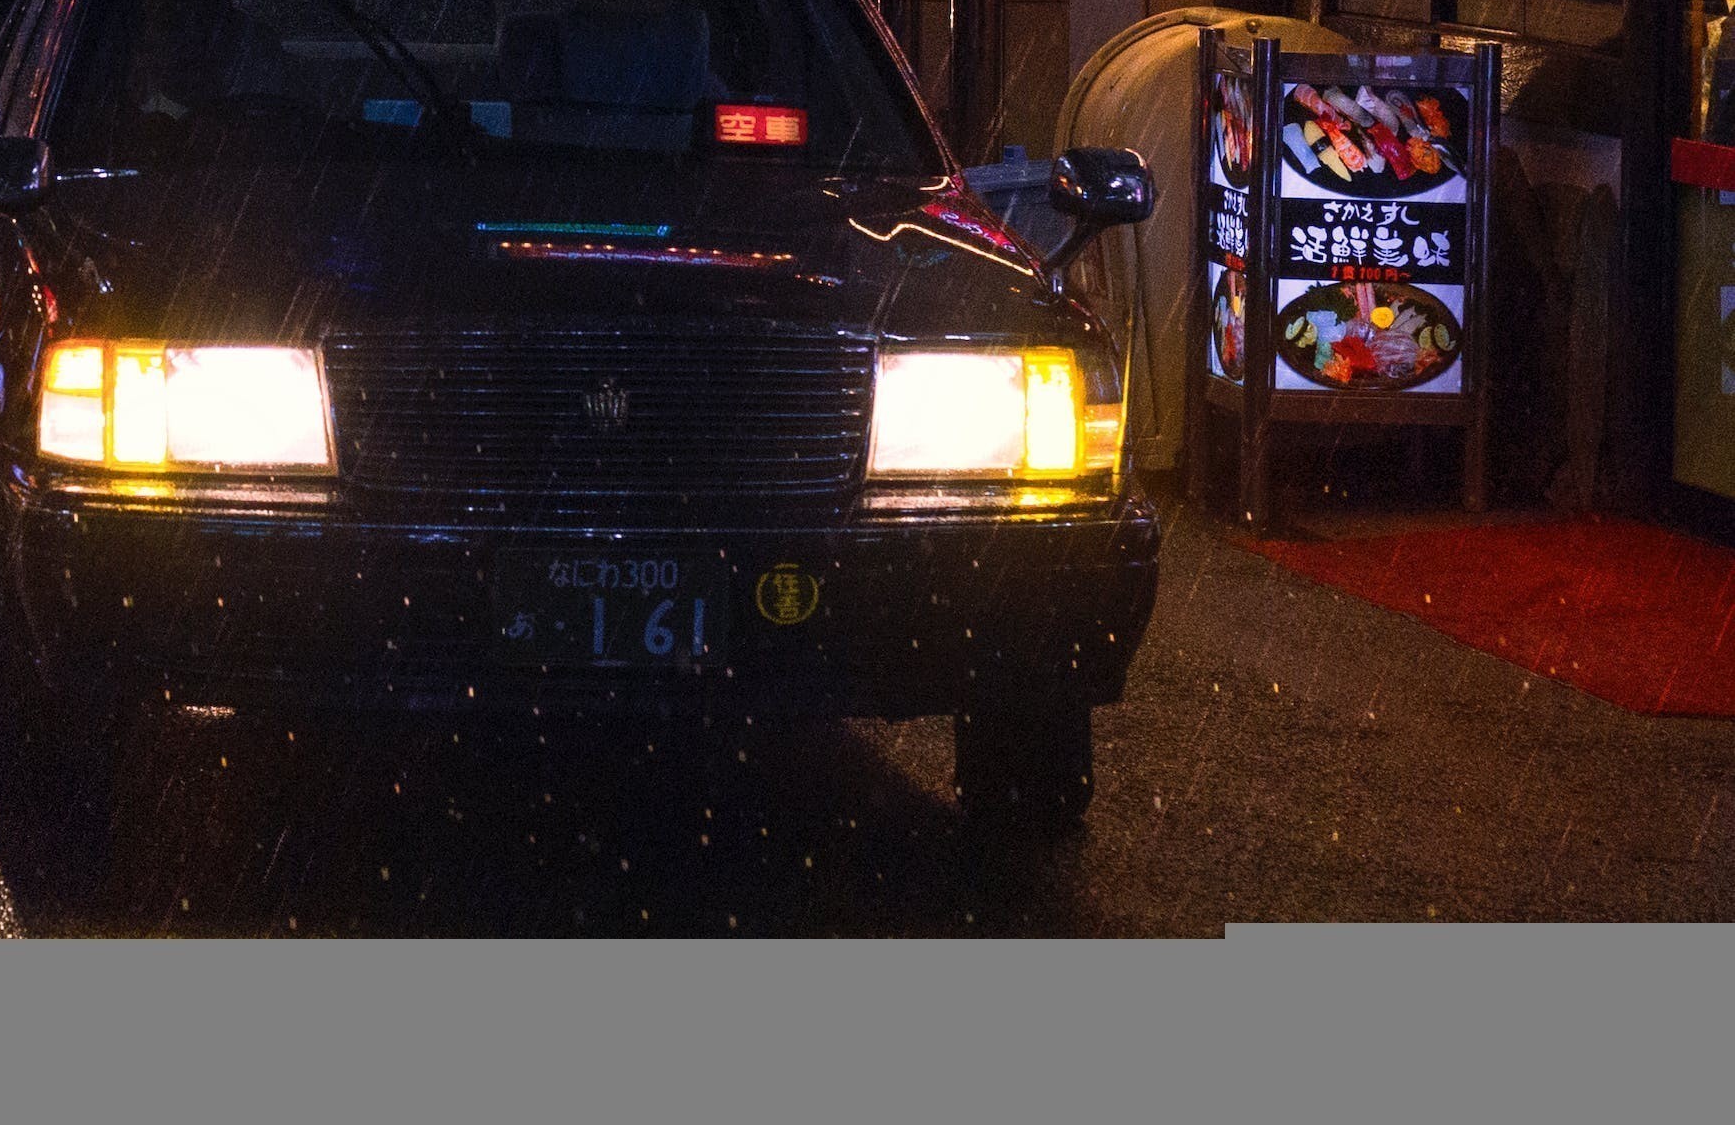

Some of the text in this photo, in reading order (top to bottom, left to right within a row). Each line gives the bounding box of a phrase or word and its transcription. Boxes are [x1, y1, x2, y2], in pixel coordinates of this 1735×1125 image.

[719, 112, 802, 143] 空車
[1323, 201, 1419, 226] さかえすし
[1290, 226, 1451, 268] 活鮮美味
